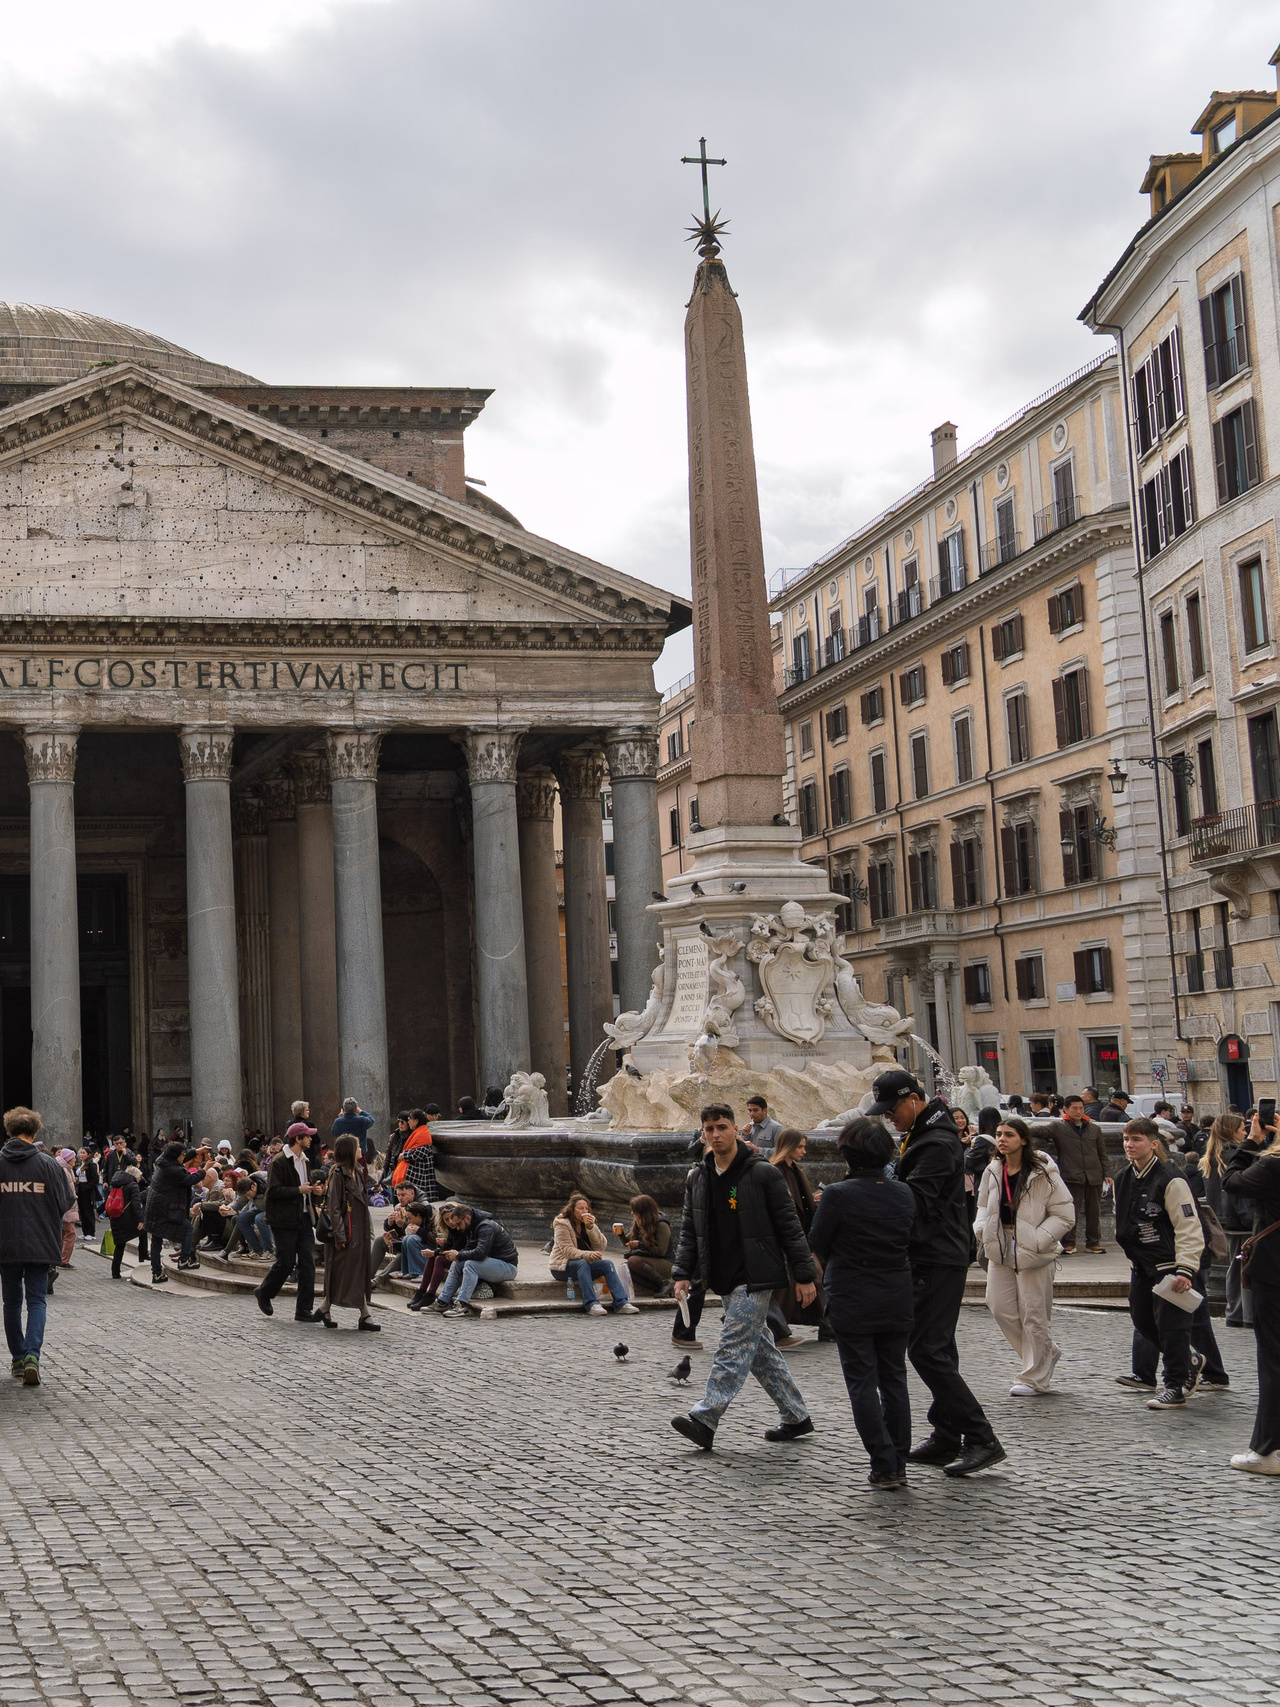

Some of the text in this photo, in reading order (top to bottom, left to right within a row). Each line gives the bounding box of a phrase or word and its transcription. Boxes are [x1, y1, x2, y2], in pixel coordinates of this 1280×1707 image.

[74, 658, 157, 688] COS
[165, 661, 348, 690] TERTIVM
[358, 662, 468, 691] FECIT
[677, 944, 703, 956] CLEMENS
[0, 1181, 45, 1194] NIKE
